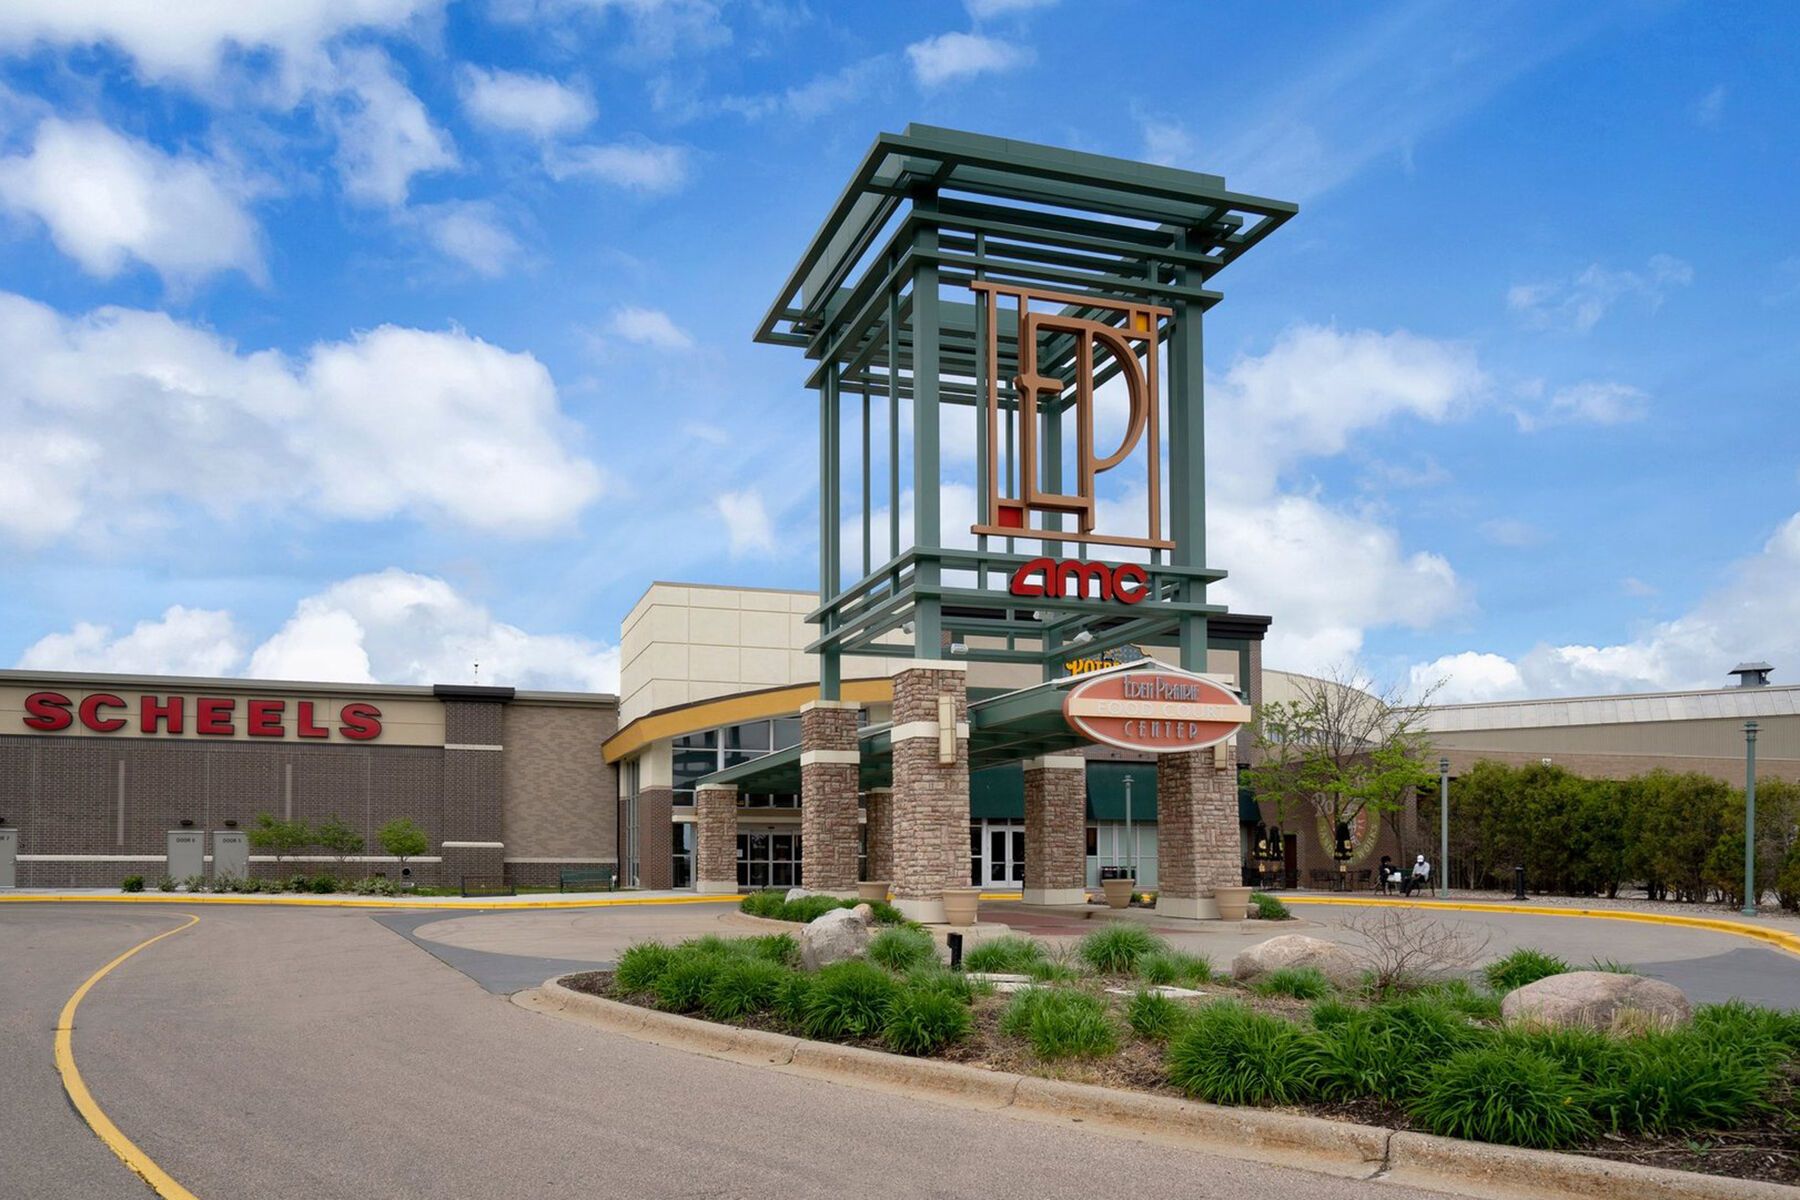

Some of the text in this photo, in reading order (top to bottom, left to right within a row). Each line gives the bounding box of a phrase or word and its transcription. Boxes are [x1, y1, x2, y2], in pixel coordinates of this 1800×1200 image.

[22, 691, 384, 740] SCHEELS
[1097, 701, 1228, 719] FOOD COURT
